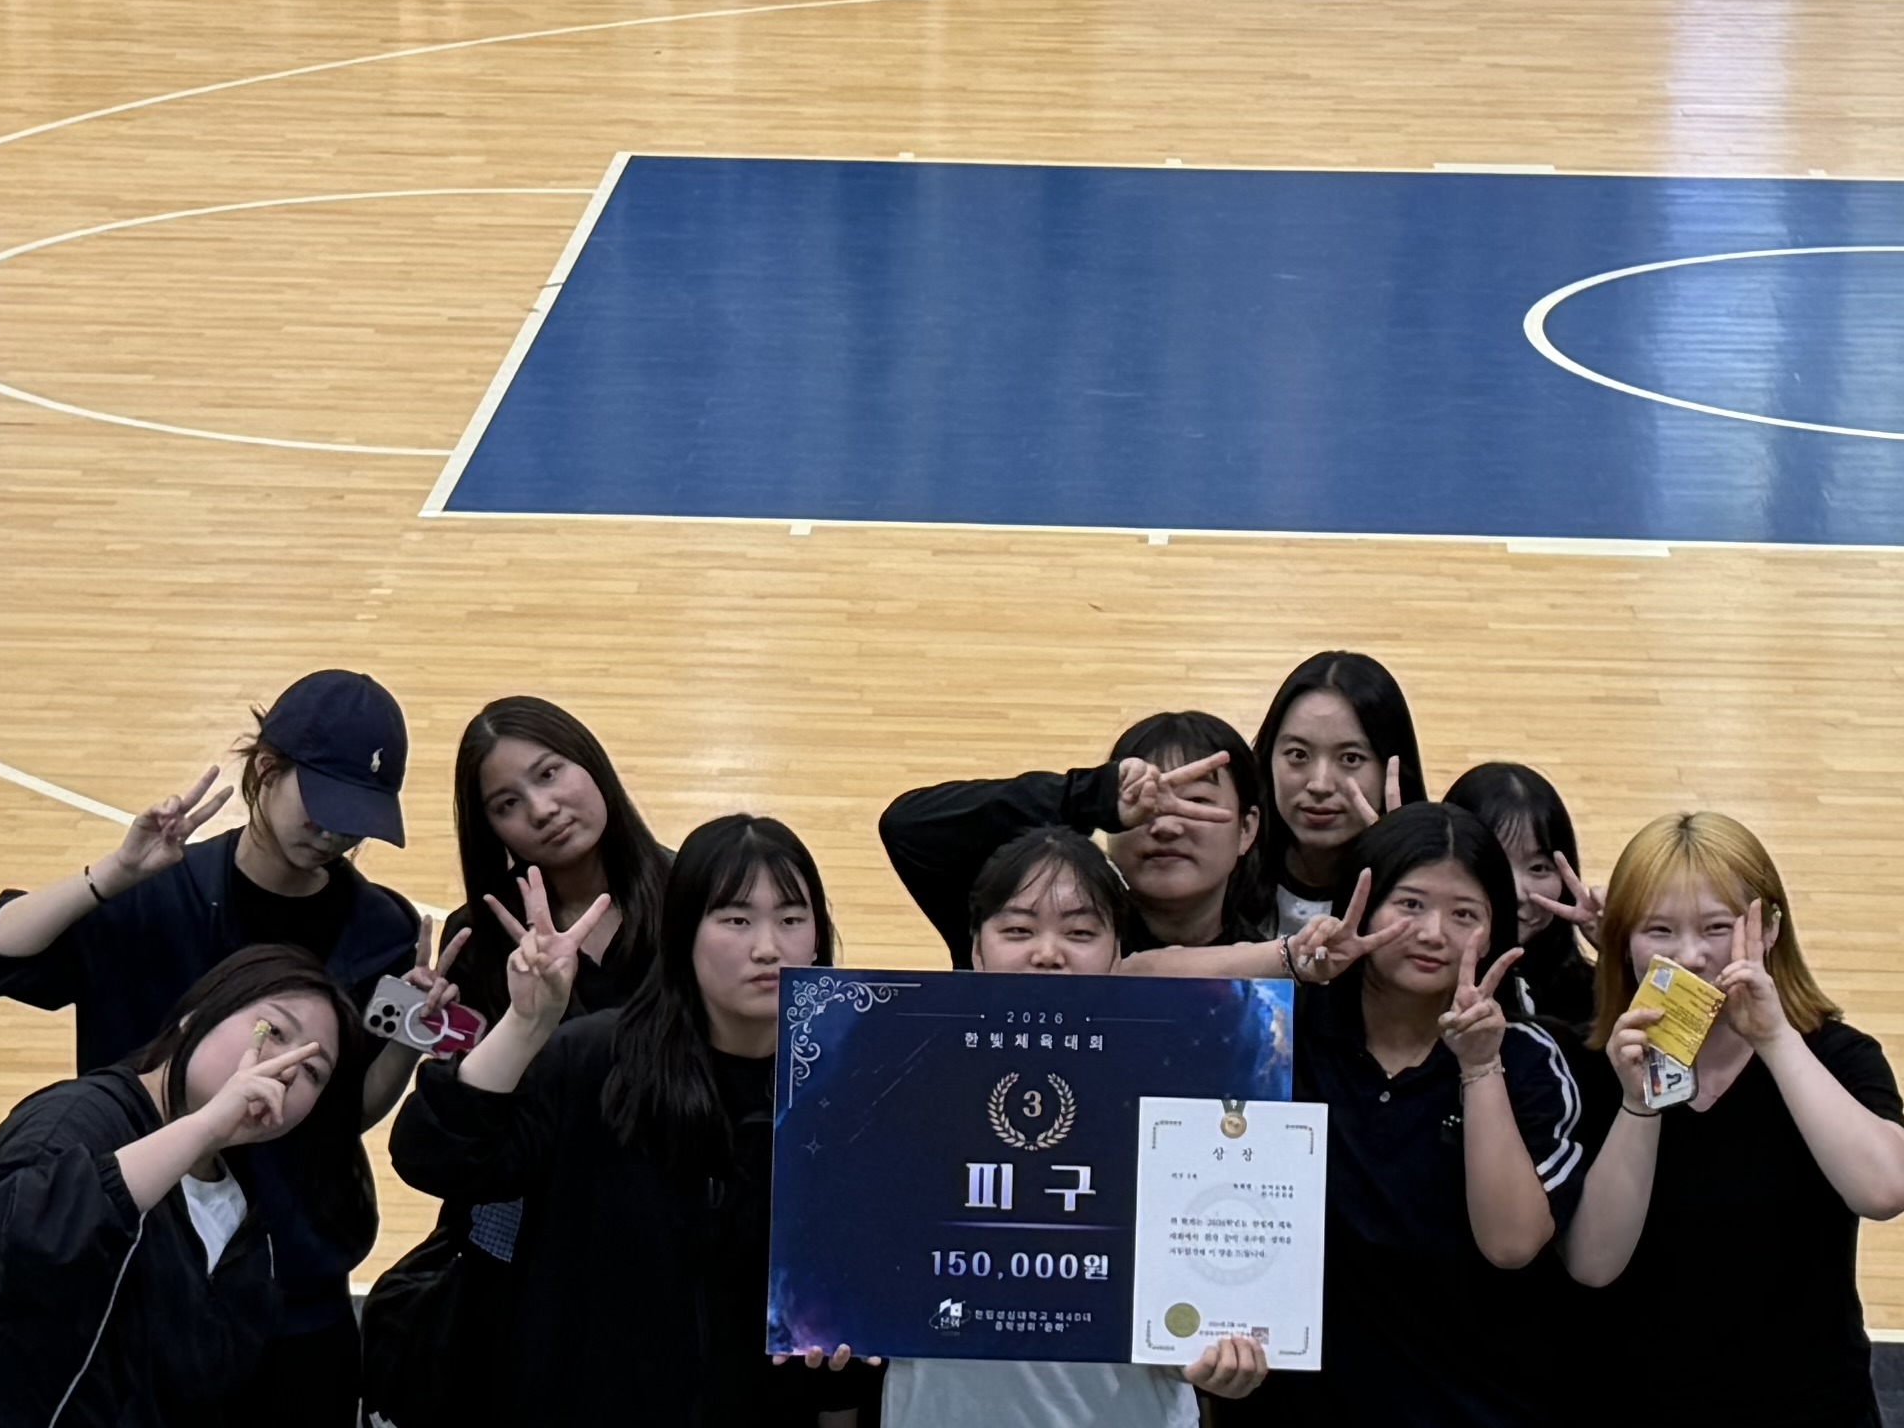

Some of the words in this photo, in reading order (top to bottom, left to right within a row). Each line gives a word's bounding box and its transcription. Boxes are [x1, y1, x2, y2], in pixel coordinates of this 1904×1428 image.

[1007, 1011, 1063, 1025] 2026
[1022, 1090, 1042, 1118] 3
[964, 1162, 1097, 1212] 피구
[931, 1250, 1109, 1281] 150,000원
